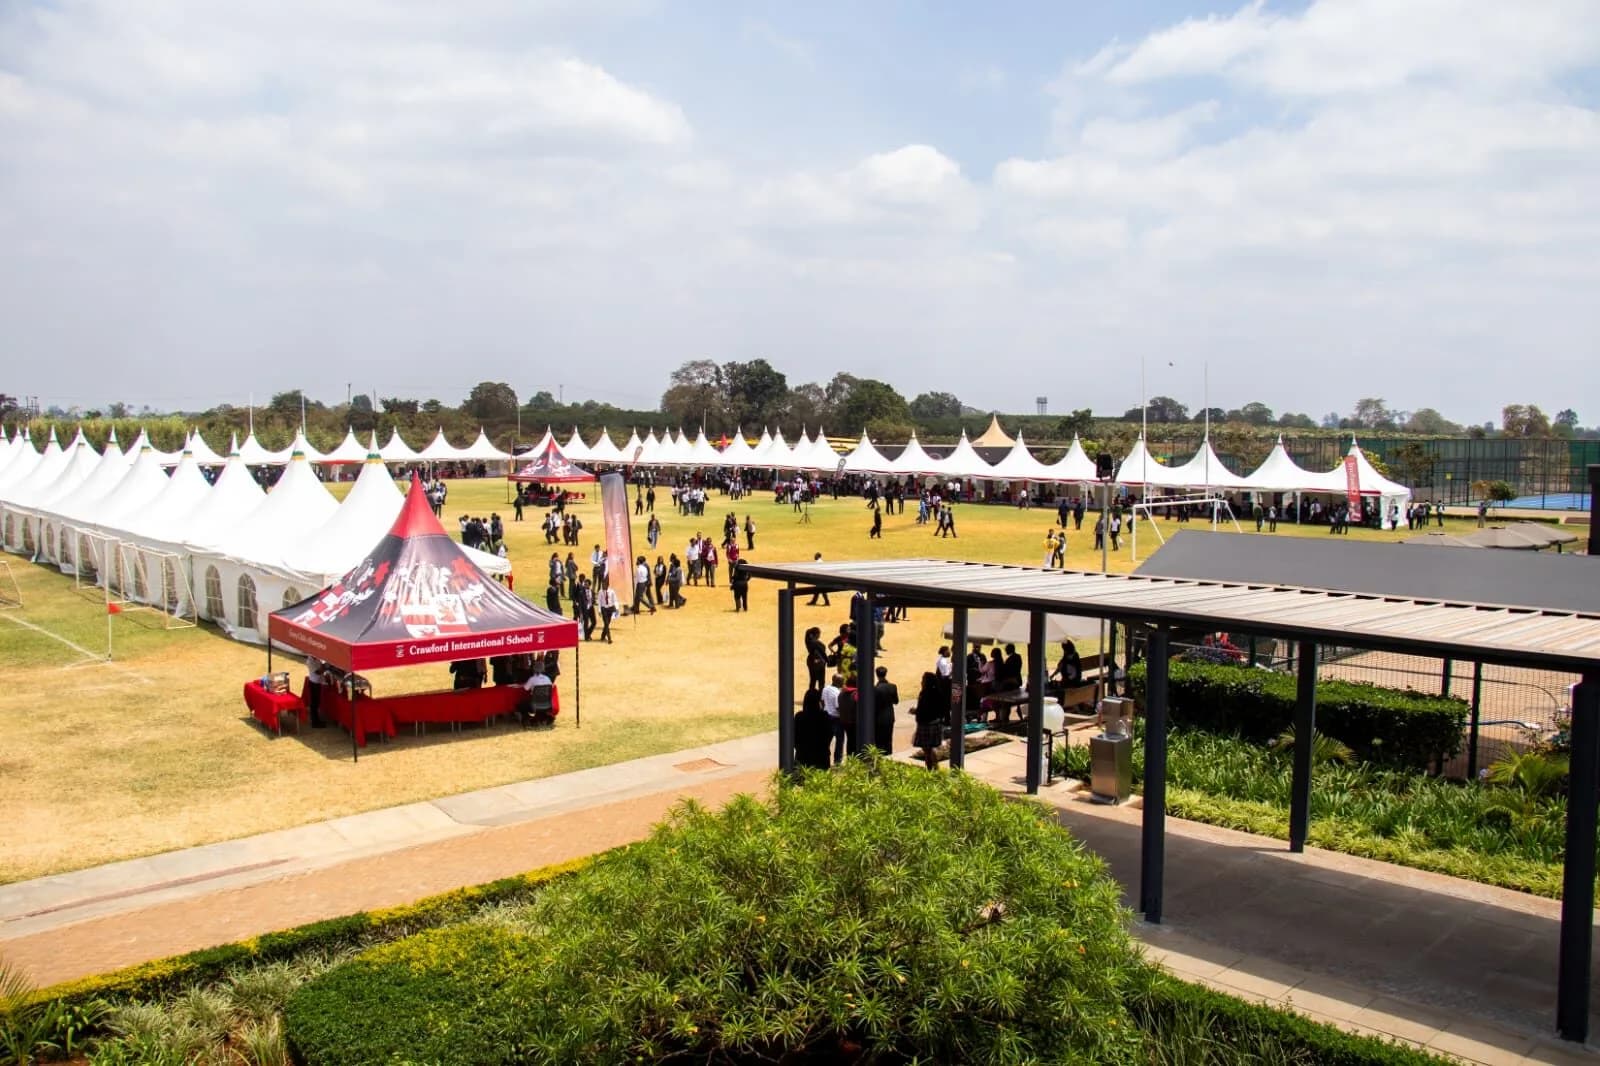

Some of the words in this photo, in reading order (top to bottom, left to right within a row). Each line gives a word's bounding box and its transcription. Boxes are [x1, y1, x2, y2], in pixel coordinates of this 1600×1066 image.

[409, 642, 449, 656] Crawford
[451, 637, 504, 651] International
[506, 633, 533, 645] School
